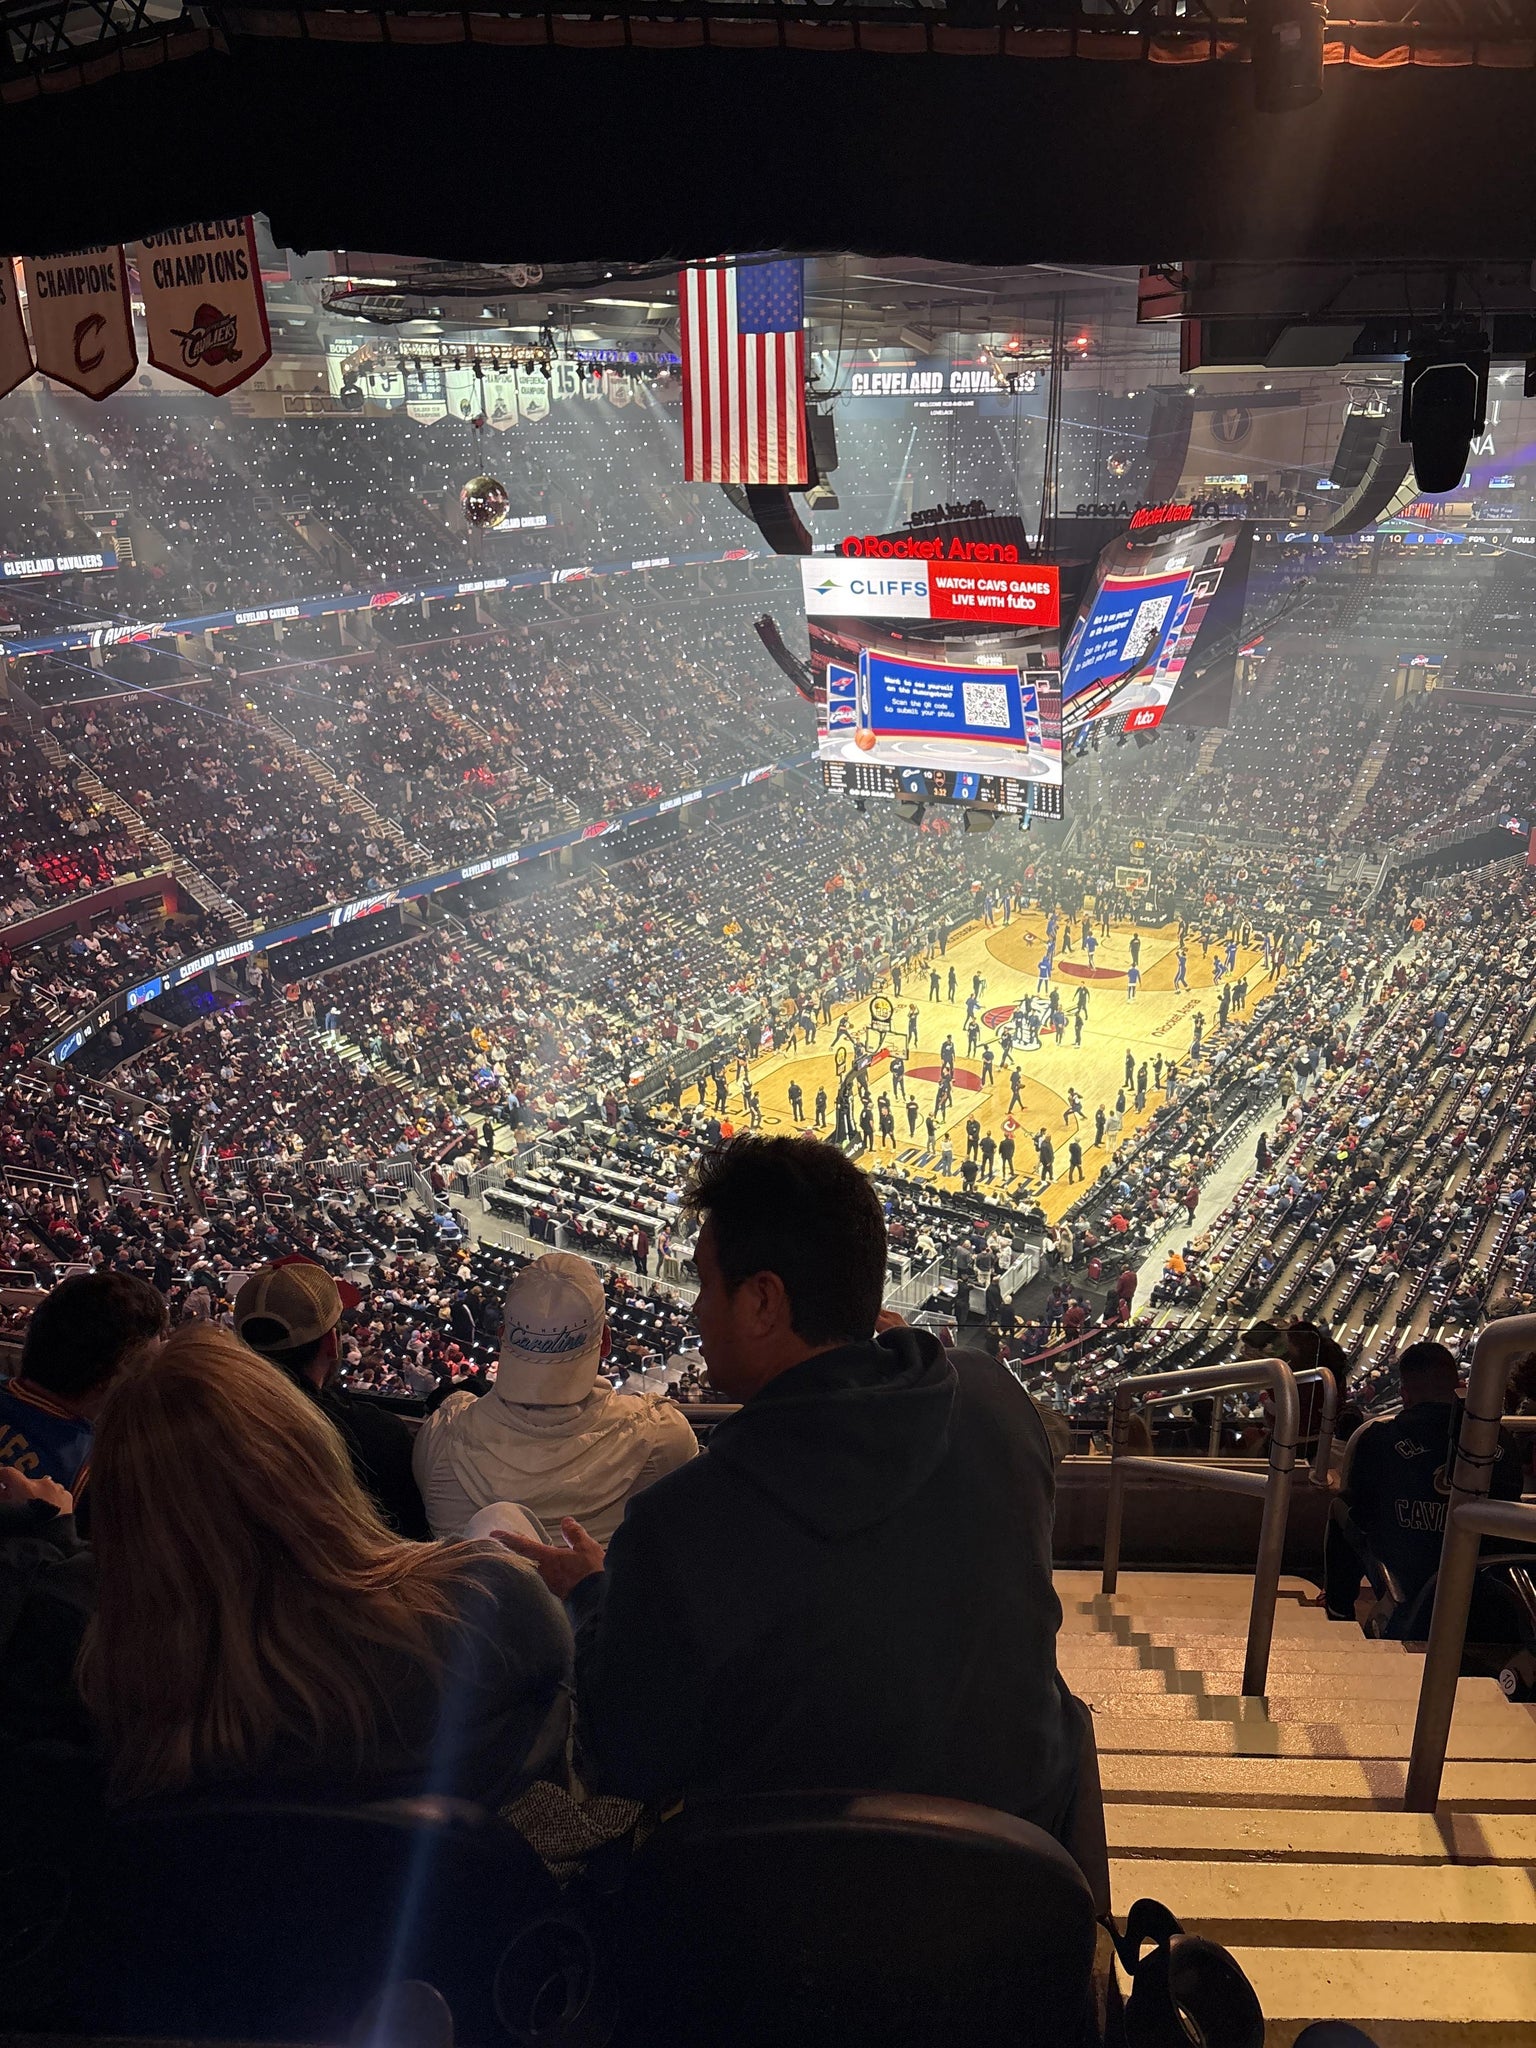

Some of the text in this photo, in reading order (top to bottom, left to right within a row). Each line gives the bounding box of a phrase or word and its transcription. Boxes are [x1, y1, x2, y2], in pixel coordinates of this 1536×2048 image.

[153, 248, 249, 289] CHAMPIONS
[36, 263, 117, 298] CHAMPIONS
[557, 365, 576, 393] 15
[852, 372, 944, 396] CLEVELAND
[864, 535, 1018, 563] Rocket Arena
[4, 554, 103, 576] CLEVELAND CAVALIERS
[850, 580, 927, 597] CLIFFS
[935, 577, 1051, 595] WATCH CAVS GAMES
[952, 594, 1036, 610] LIVE WITH fubo
[1133, 710, 1155, 726] fubo
[911, 781, 918, 793] 0
[962, 788, 969, 798] 0
[180, 940, 254, 979] CLEVELAND CAVALIERS
[1502, 1673, 1514, 1690] 10
